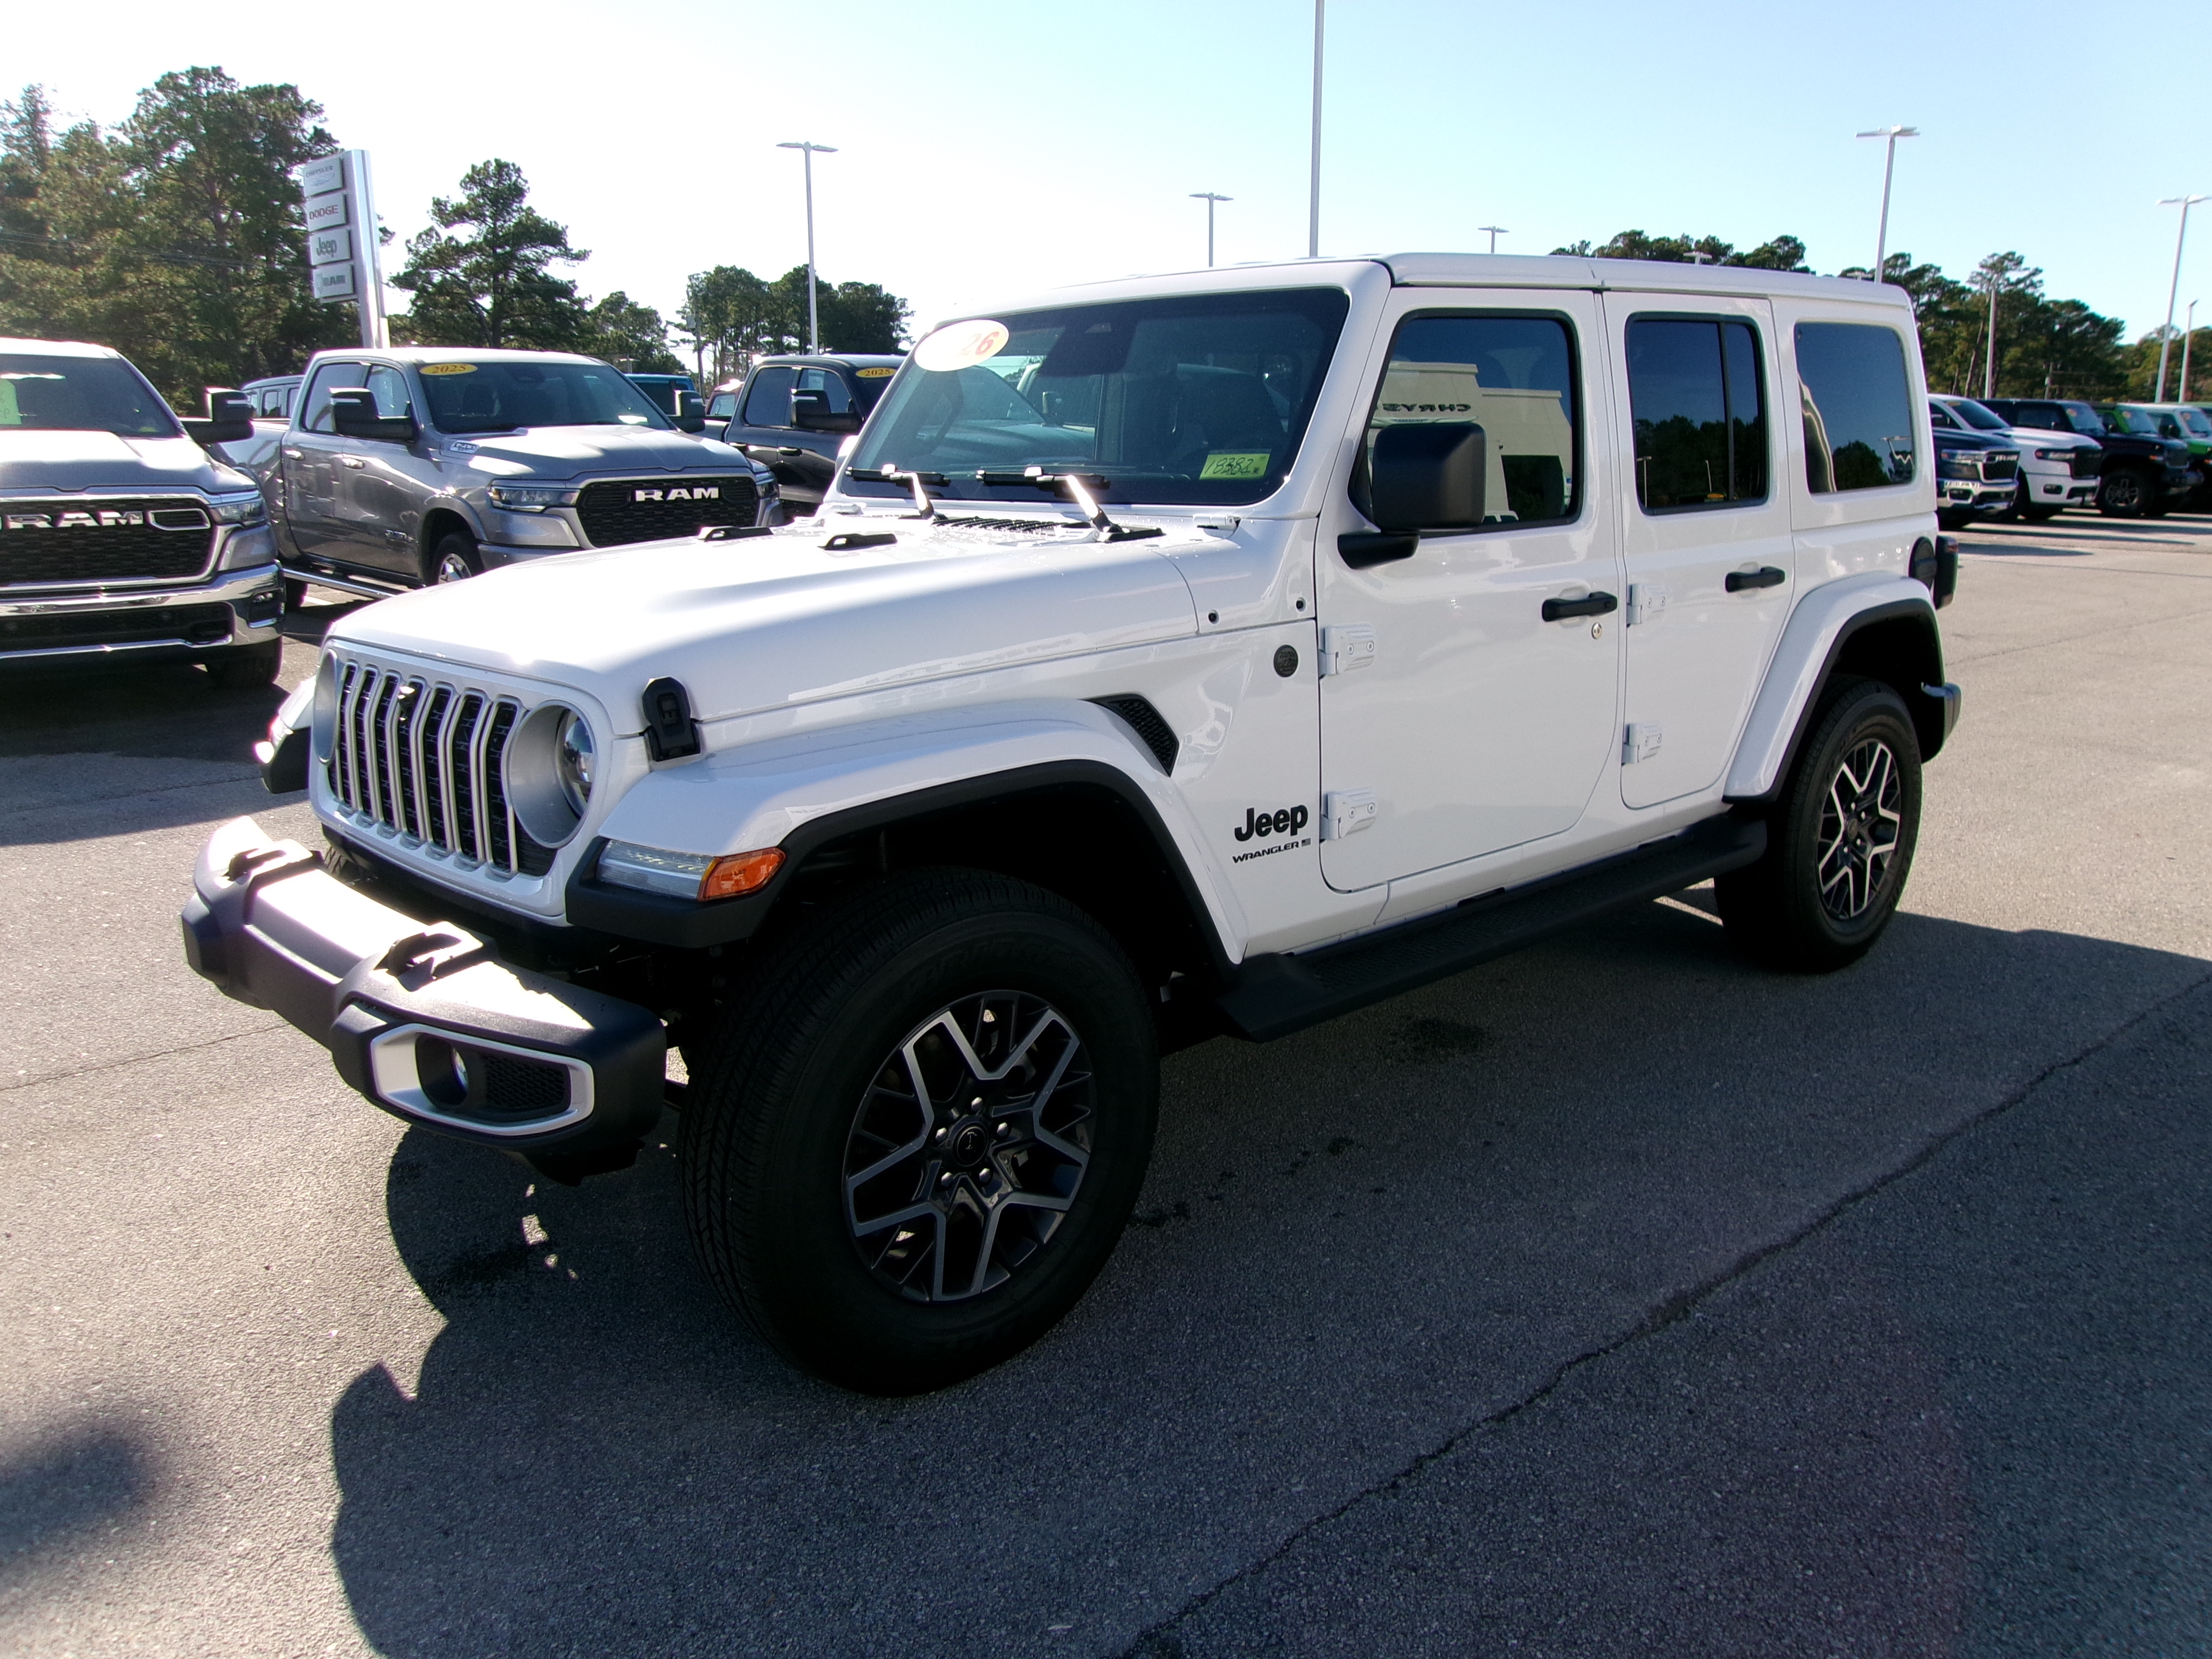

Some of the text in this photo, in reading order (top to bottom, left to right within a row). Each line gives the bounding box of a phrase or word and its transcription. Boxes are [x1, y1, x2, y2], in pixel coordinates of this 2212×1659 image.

[306, 165, 334, 177] CHRYSLER
[309, 204, 339, 219] DODGE
[316, 237, 337, 258] Jeep
[432, 364, 467, 374] 2025
[865, 368, 891, 377] 2025
[635, 487, 719, 502] RAM
[5, 511, 144, 529] RAM
[1234, 805, 1309, 842] Jeep
[1232, 841, 1299, 864] WRANGLER
